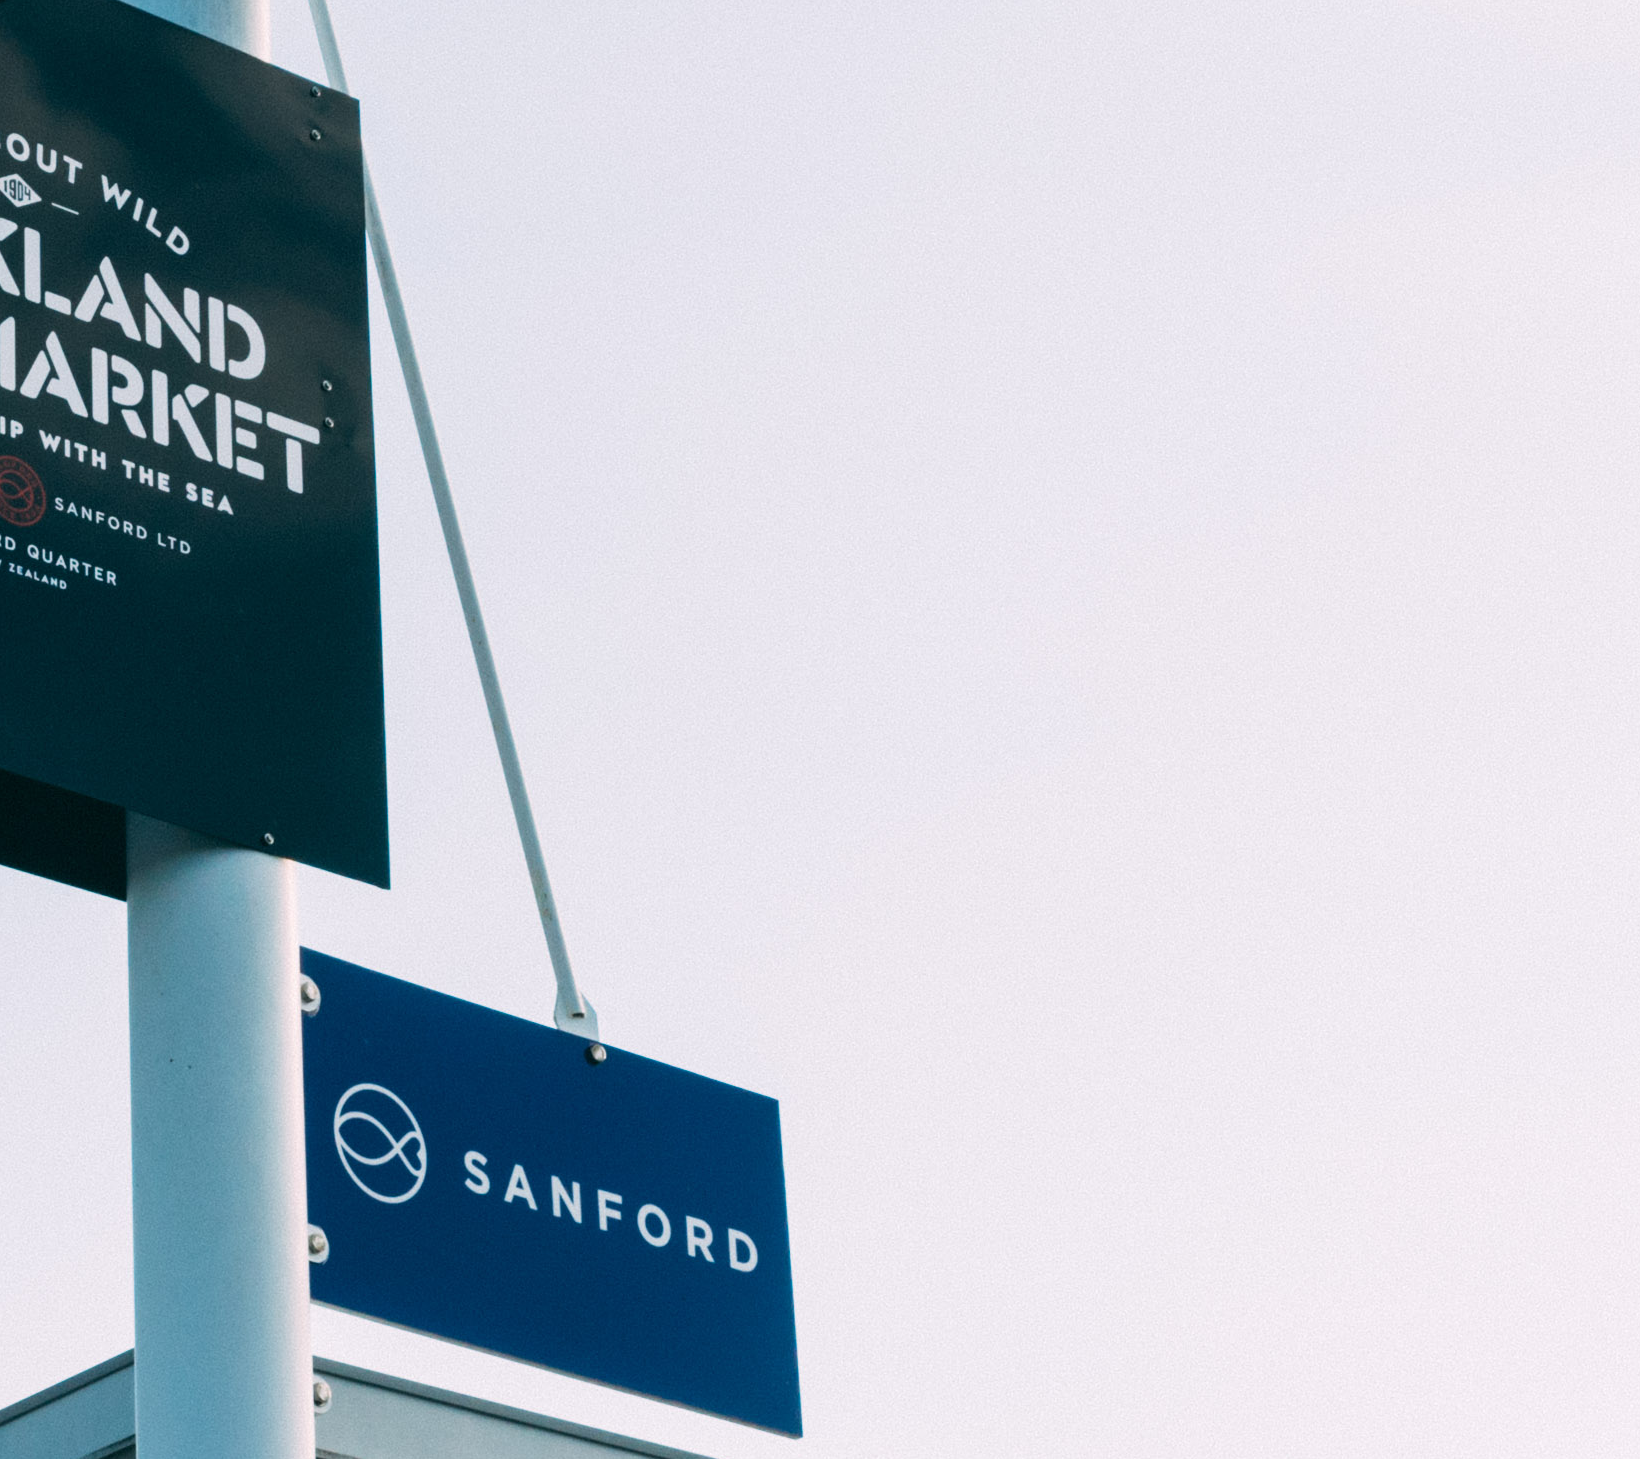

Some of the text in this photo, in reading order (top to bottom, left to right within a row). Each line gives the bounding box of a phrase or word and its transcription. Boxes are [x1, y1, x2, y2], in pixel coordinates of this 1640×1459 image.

[3, 178, 32, 202] 1904
[100, 174, 190, 256] WILD
[38, 429, 107, 471] WITH
[121, 458, 171, 493] THE
[185, 482, 234, 516] SEA
[54, 497, 148, 540] SANFORD
[157, 532, 191, 555] LTD
[8, 562, 67, 590] ZEALAND
[27, 544, 117, 587] QUARTER
[463, 1150, 759, 1273] SANFORD
